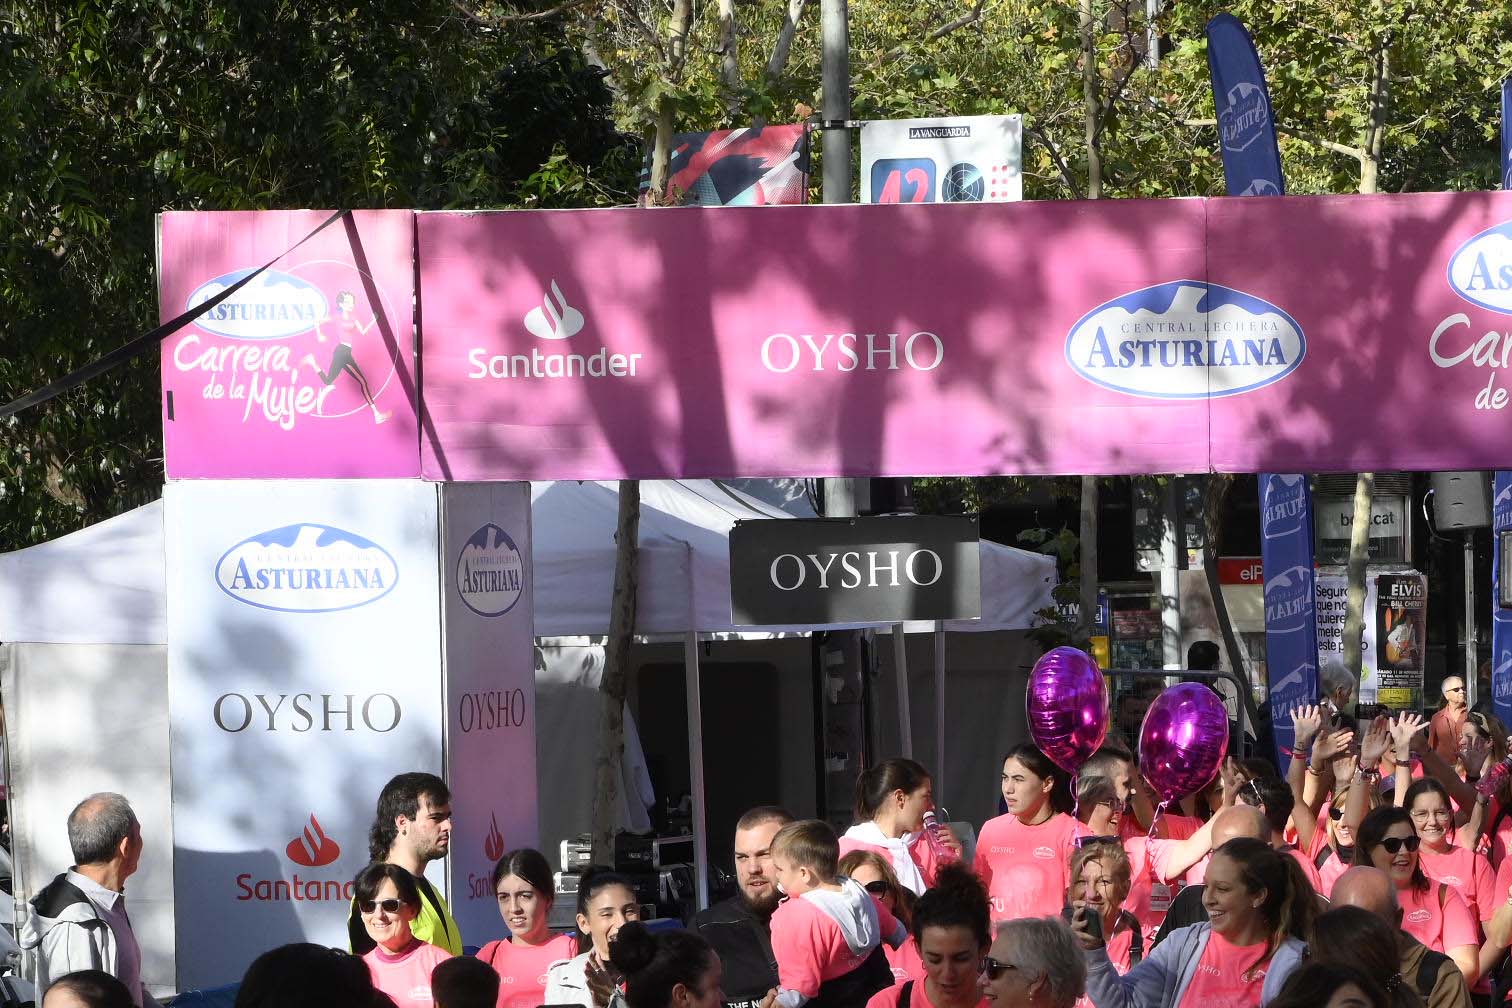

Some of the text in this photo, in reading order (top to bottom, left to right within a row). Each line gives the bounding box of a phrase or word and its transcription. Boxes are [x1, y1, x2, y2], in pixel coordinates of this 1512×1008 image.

[921, 127, 970, 138] VANGUARDIA
[1121, 320, 1280, 333] CENTRAL LECHERA
[173, 334, 291, 372] Carrera
[468, 346, 642, 379] Santander
[760, 331, 944, 373] OYSHO
[1086, 327, 1288, 369] ASTURIANA
[203, 368, 336, 430] de la Mujer
[1475, 372, 1510, 410] de
[230, 557, 385, 589] ASTURIANA
[462, 559, 520, 593] ASTURIANA
[769, 549, 944, 591] OYSHO
[1316, 601, 1333, 612] que
[1391, 584, 1421, 596] ELVIS
[1319, 642, 1337, 651] este
[213, 692, 402, 733] OYSHO
[459, 688, 526, 733] OYSHO
